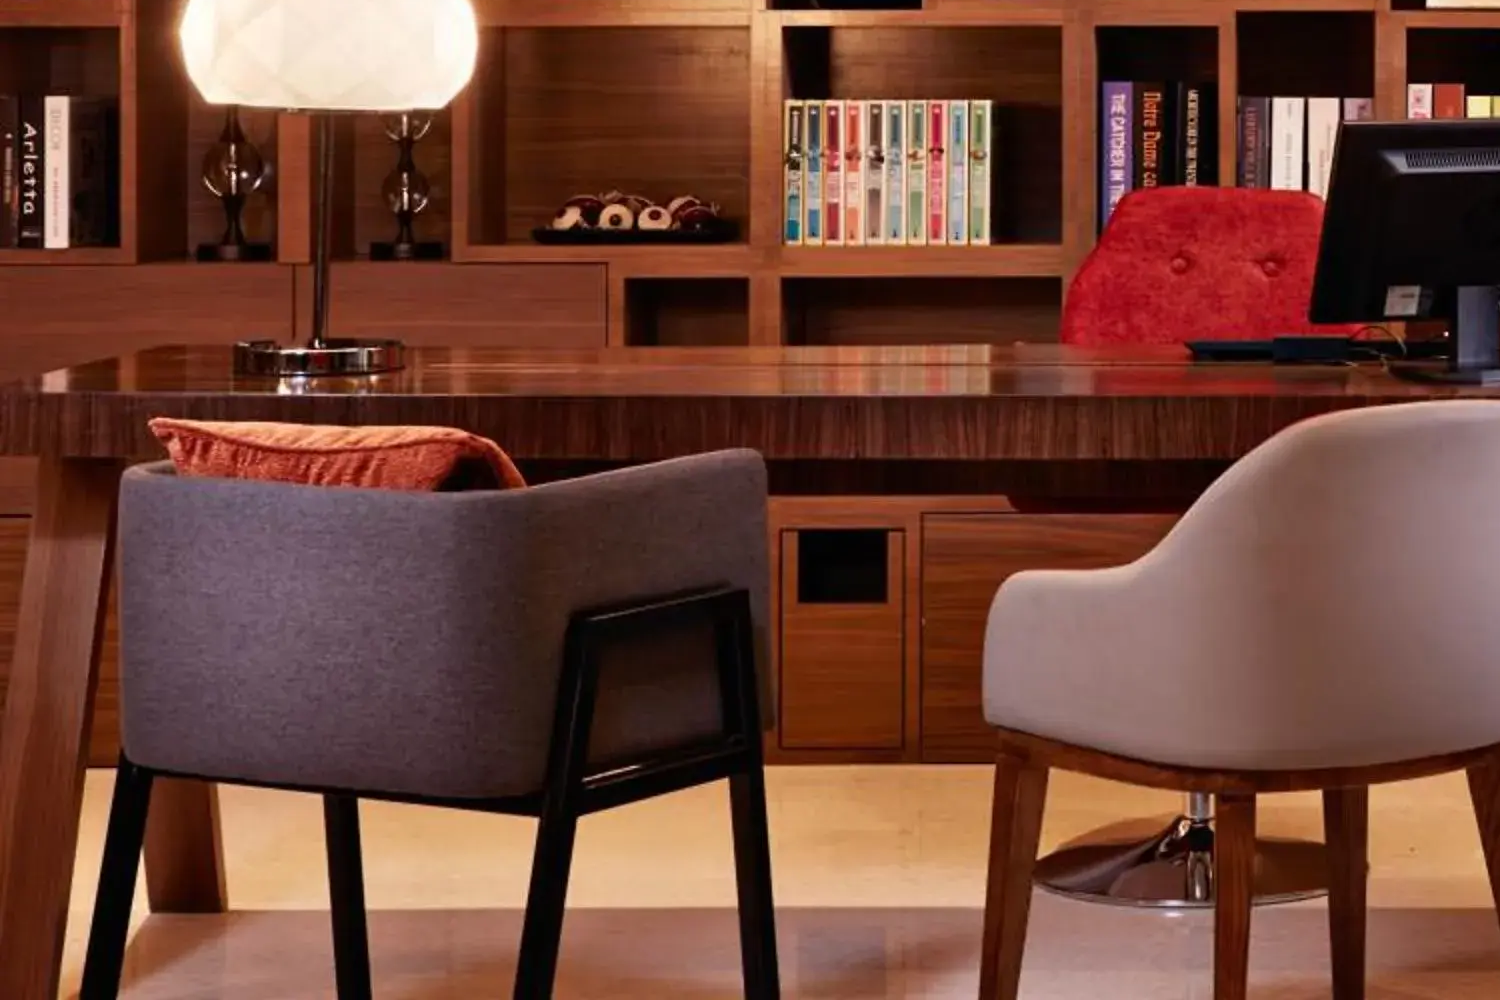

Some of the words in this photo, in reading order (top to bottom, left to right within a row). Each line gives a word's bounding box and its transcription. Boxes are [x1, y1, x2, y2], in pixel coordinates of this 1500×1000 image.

[1111, 94, 1125, 115] THE
[1110, 117, 1126, 166] CATCHER
[1143, 131, 1161, 167] Dame
[22, 122, 40, 215] Arletta
[1111, 169, 1125, 181] IN
